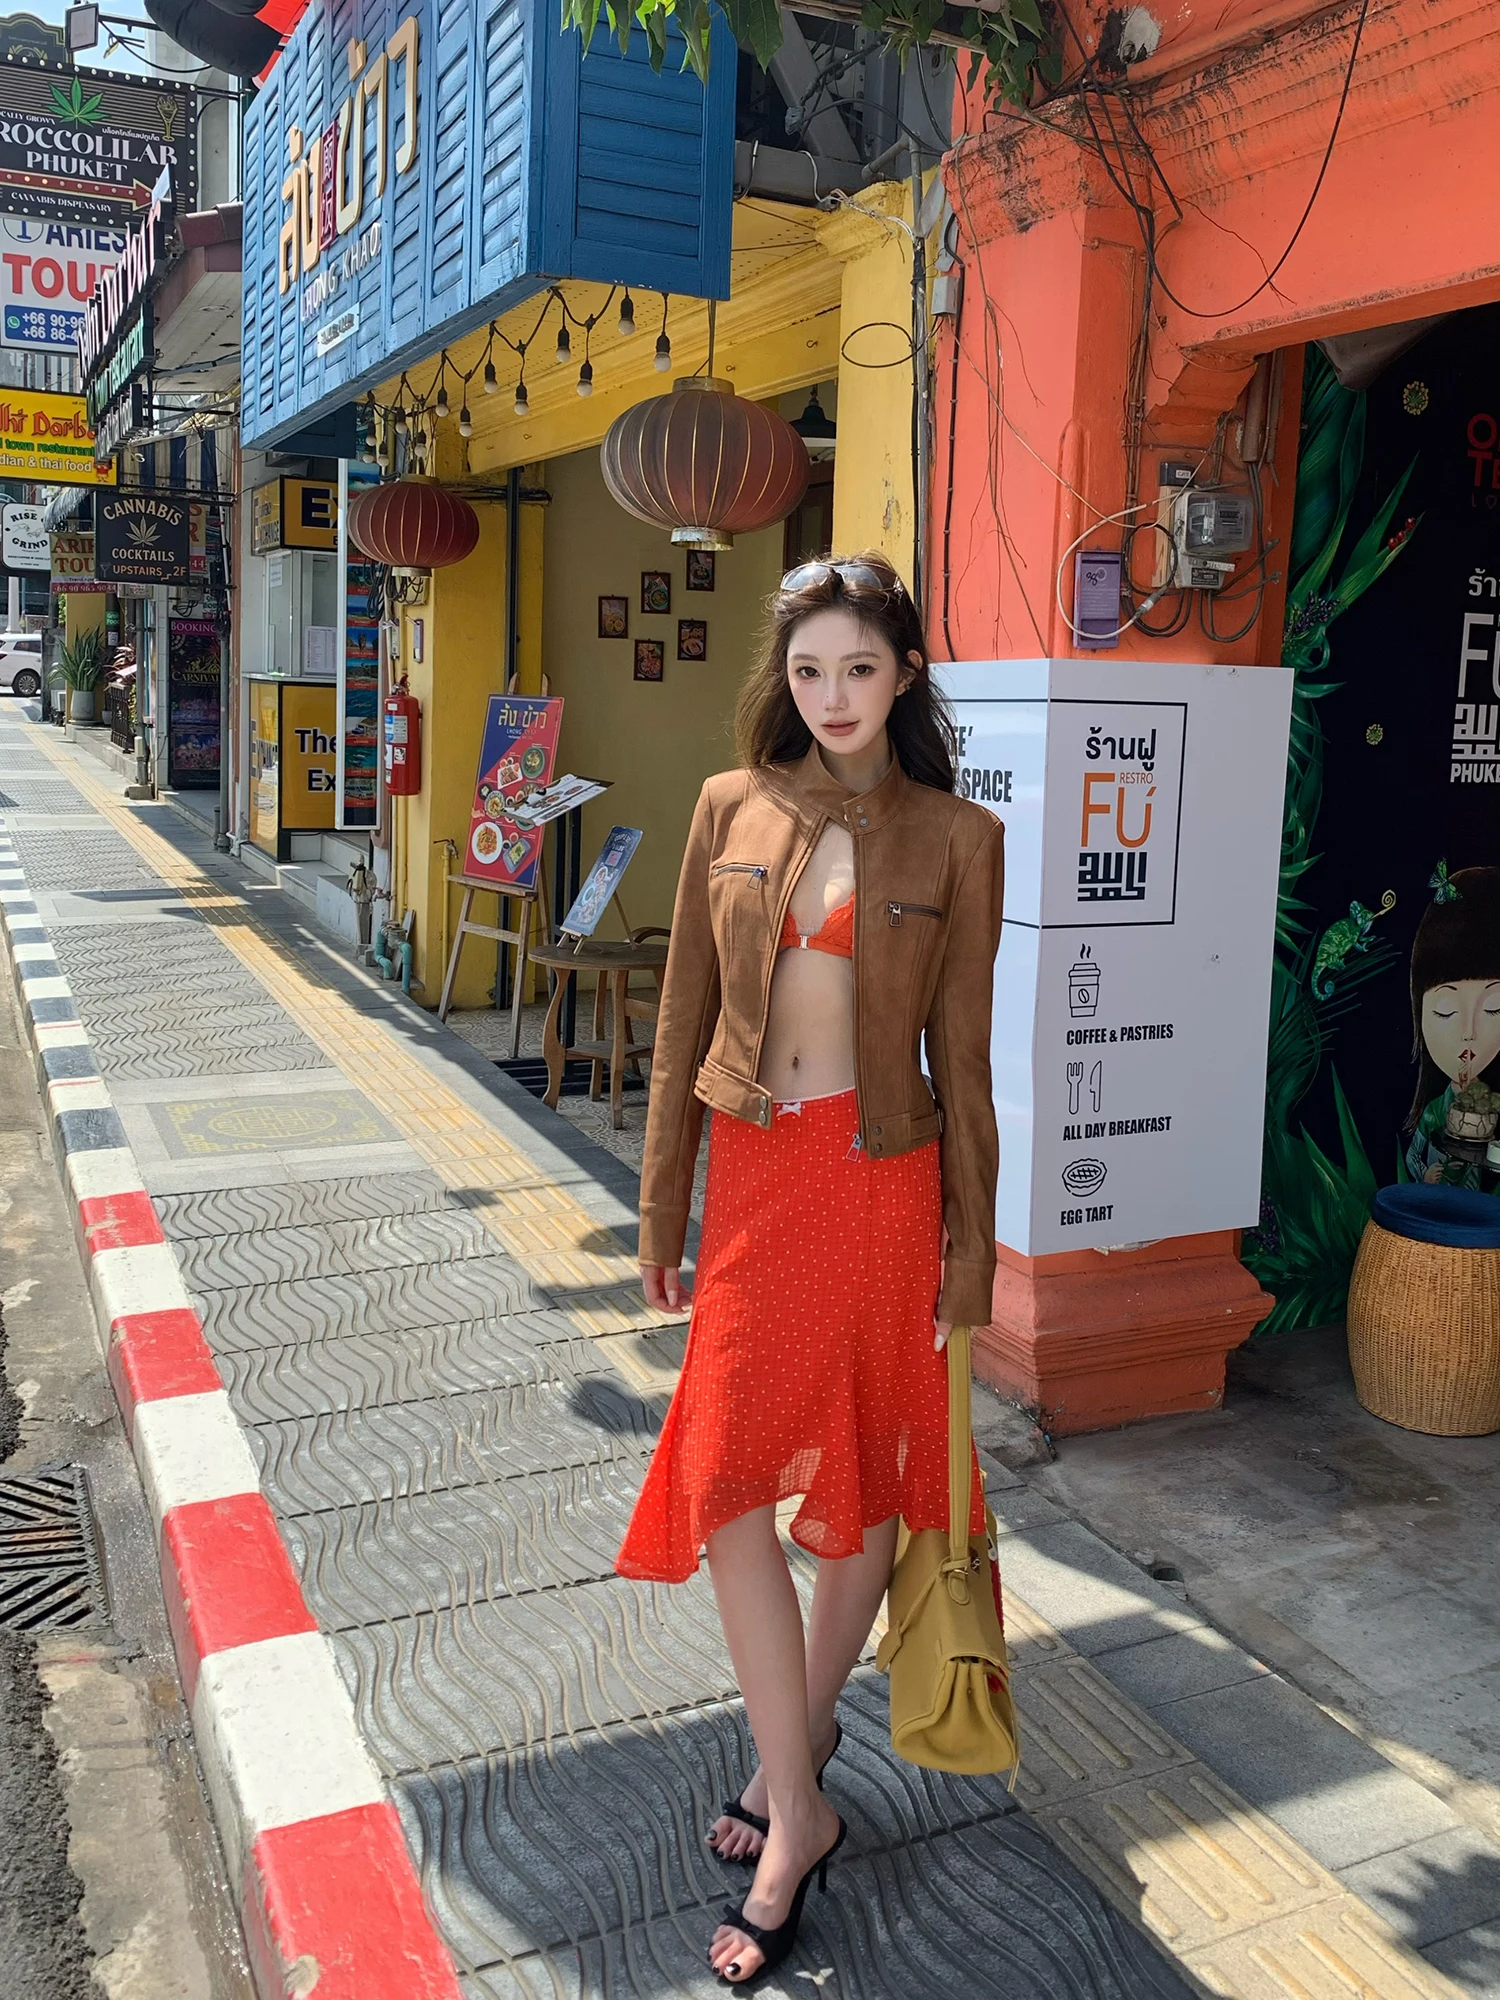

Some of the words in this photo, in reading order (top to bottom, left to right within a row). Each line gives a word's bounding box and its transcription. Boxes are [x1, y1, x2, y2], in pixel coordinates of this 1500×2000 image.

[0, 110, 24, 120] CALLY
[26, 114, 56, 125] GROWN
[27, 151, 128, 181] PHUKET
[11, 192, 56, 205] CANNABIS
[58, 198, 113, 213] DISPENSARY
[46, 224, 127, 253] ARIES
[3, 252, 116, 303] TOU
[301, 262, 339, 323] LHONG
[342, 222, 382, 283] KHAO
[22, 312, 46, 326] +66
[22, 326, 46, 340] +66
[1467, 413, 1500, 450] O
[5, 439, 35, 452] town
[37, 443, 95, 457] restaurant
[28, 456, 37, 467] &
[40, 458, 62, 470] thai
[66, 459, 93, 472] food
[10, 512, 38, 522] RISE
[103, 499, 183, 526] CANNABIS
[12, 537, 49, 549] GRIND
[112, 548, 175, 562] COCKTAILS
[113, 565, 163, 576] UPSTAIRS
[173, 566, 187, 577] 2F
[1457, 612, 1500, 699] F
[1085, 727, 1157, 771] ร้านฝู
[961, 767, 1013, 803] SPACE
[1119, 772, 1154, 784] RESTRO
[1066, 1028, 1107, 1046] COFFEE
[1109, 1029, 1118, 1043] &
[1120, 1023, 1174, 1042] PASTRIES
[1063, 1125, 1082, 1141] ALL
[1085, 1122, 1107, 1139] DAY
[1109, 1116, 1172, 1137] BREAKFAST
[1060, 1208, 1083, 1226] EGG
[1085, 1204, 1114, 1223] TART
